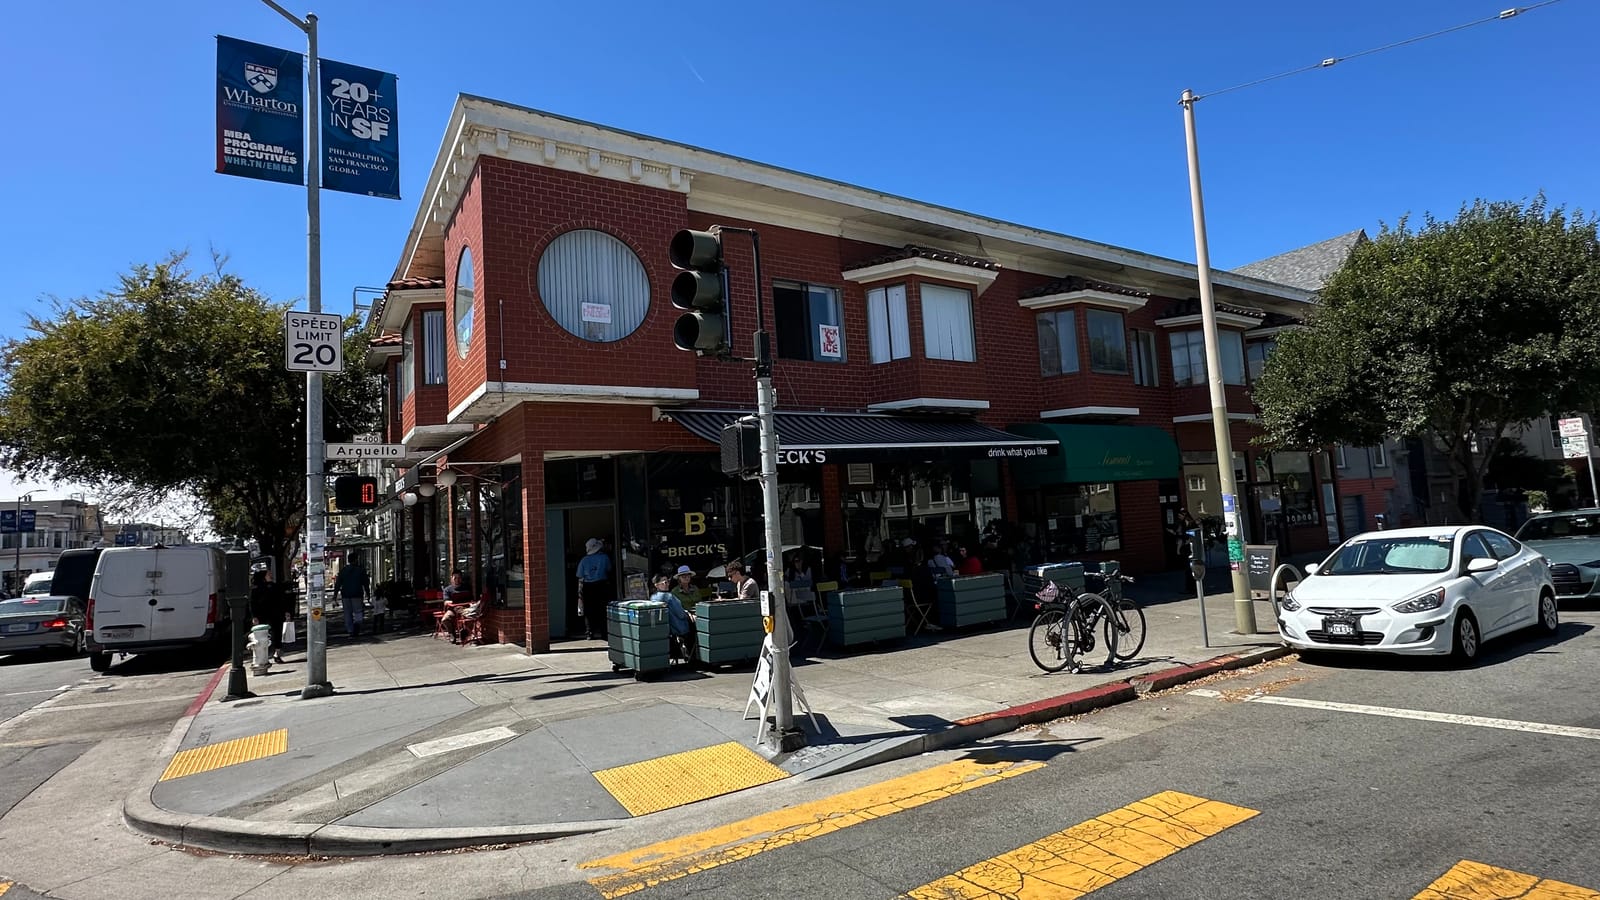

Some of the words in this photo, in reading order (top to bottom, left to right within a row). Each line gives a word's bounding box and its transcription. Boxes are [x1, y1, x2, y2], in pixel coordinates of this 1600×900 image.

[331, 78, 383, 103] 20+
[223, 86, 297, 113] Wharton
[327, 95, 391, 123] YEARS
[330, 112, 348, 129] IN
[351, 117, 389, 141] SF
[223, 129, 251, 141] MBA
[223, 138, 284, 154] PROGRAM
[223, 146, 298, 165] EXECUTIVES
[328, 147, 385, 163] PHILADELPHIA
[223, 155, 294, 174] WHR.TN/EMBA
[328, 156, 344, 165] SAN
[346, 158, 389, 173] FRANCISCO
[328, 165, 361, 176] GLOBAL
[291, 318, 338, 330] SPEED
[296, 330, 333, 342] LIMIT
[293, 342, 336, 366] 20
[823, 343, 838, 354] ICE
[336, 445, 398, 458] Arguello
[775, 450, 826, 464] ECK'S
[988, 448, 1006, 457] drink
[1006, 448, 1023, 457] what
[1023, 449, 1036, 459] you
[1036, 446, 1048, 455] like
[361, 483, 375, 504] 10
[684, 511, 706, 536] B
[668, 543, 727, 558] BRECK'S
